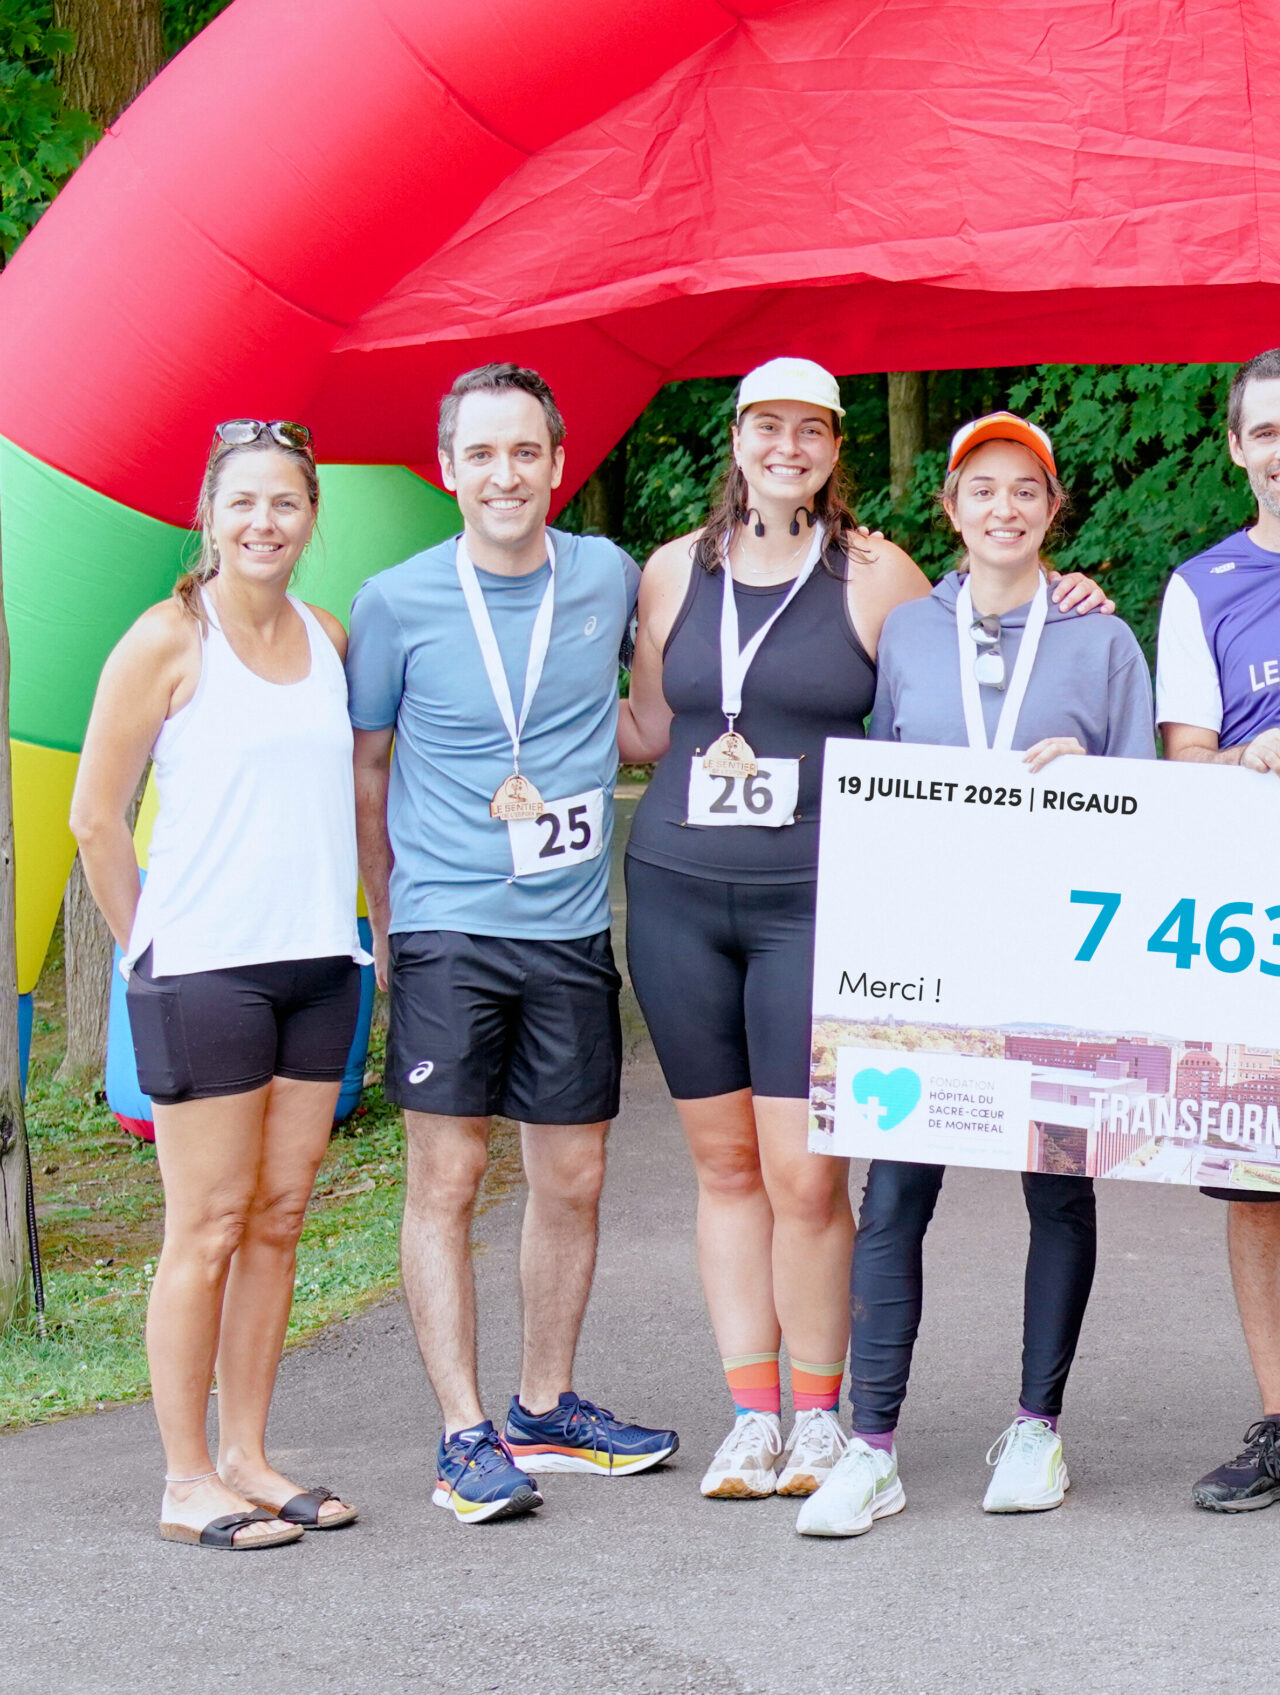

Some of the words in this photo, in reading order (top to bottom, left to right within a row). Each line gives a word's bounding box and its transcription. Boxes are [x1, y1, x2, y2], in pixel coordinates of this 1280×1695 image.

[1249, 660, 1280, 692] LE
[709, 769, 774, 815] 26
[839, 776, 862, 795] 19
[865, 776, 959, 802] JUILLET
[964, 785, 1022, 807] 2025
[1042, 790, 1138, 815] RIGAUD
[535, 804, 591, 858] 25
[1070, 889, 1122, 962] 7
[839, 971, 925, 1002] Merci
[929, 1076, 995, 1091] FONDATION
[929, 1089, 976, 1103] HÔPITAL
[978, 1094, 994, 1105] DU
[928, 1118, 942, 1129] DE
